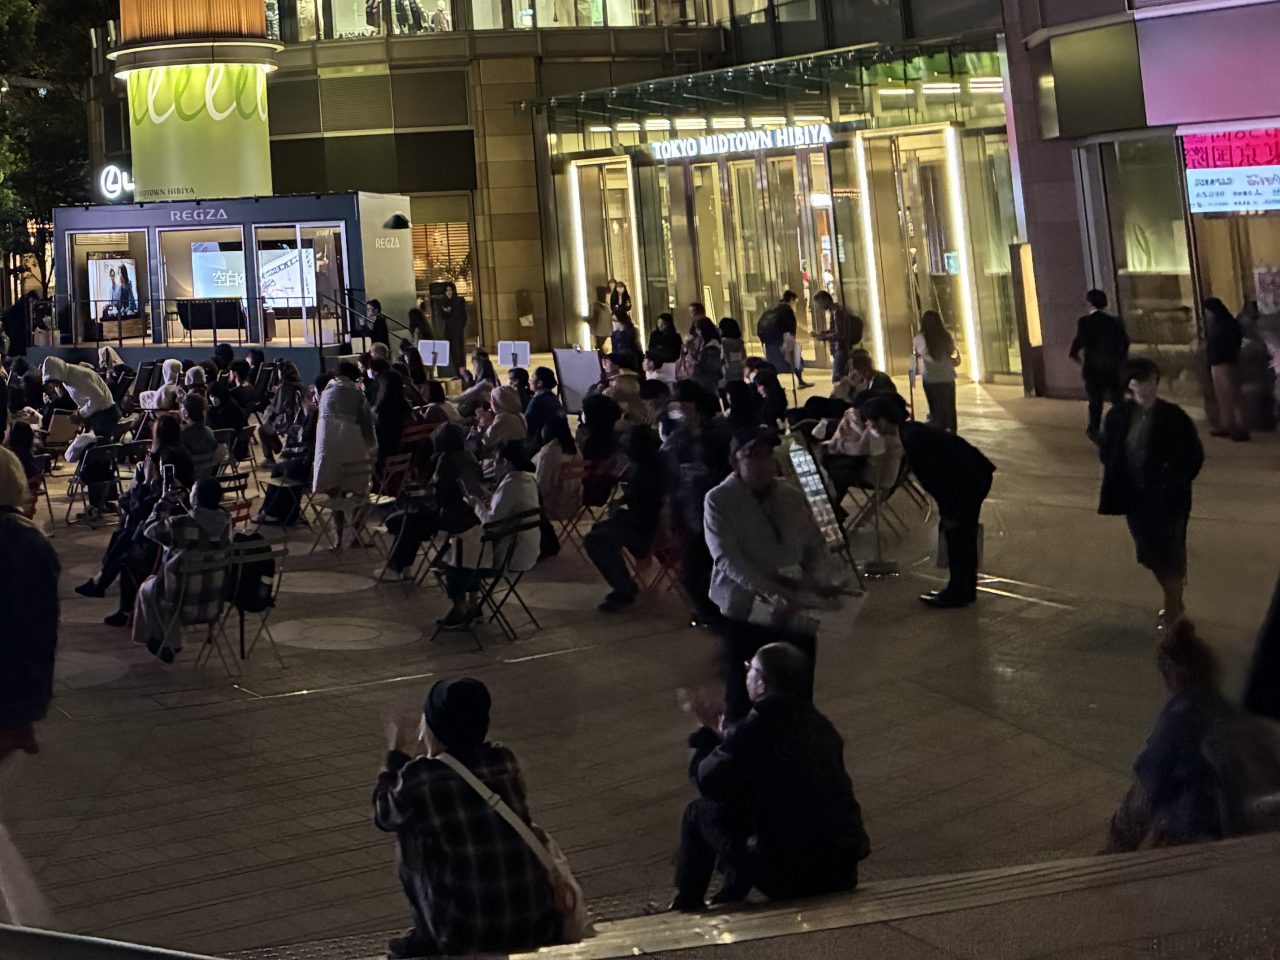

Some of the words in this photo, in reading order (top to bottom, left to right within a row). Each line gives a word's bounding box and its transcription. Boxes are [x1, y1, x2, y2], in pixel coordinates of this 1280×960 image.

[652, 137, 698, 159] TOKYO
[700, 130, 774, 155] MIDTOWN
[775, 123, 833, 147] HIBIYA
[167, 187, 195, 196] HIBIYA
[170, 208, 228, 221] REGZA
[375, 237, 400, 248] REGZA
